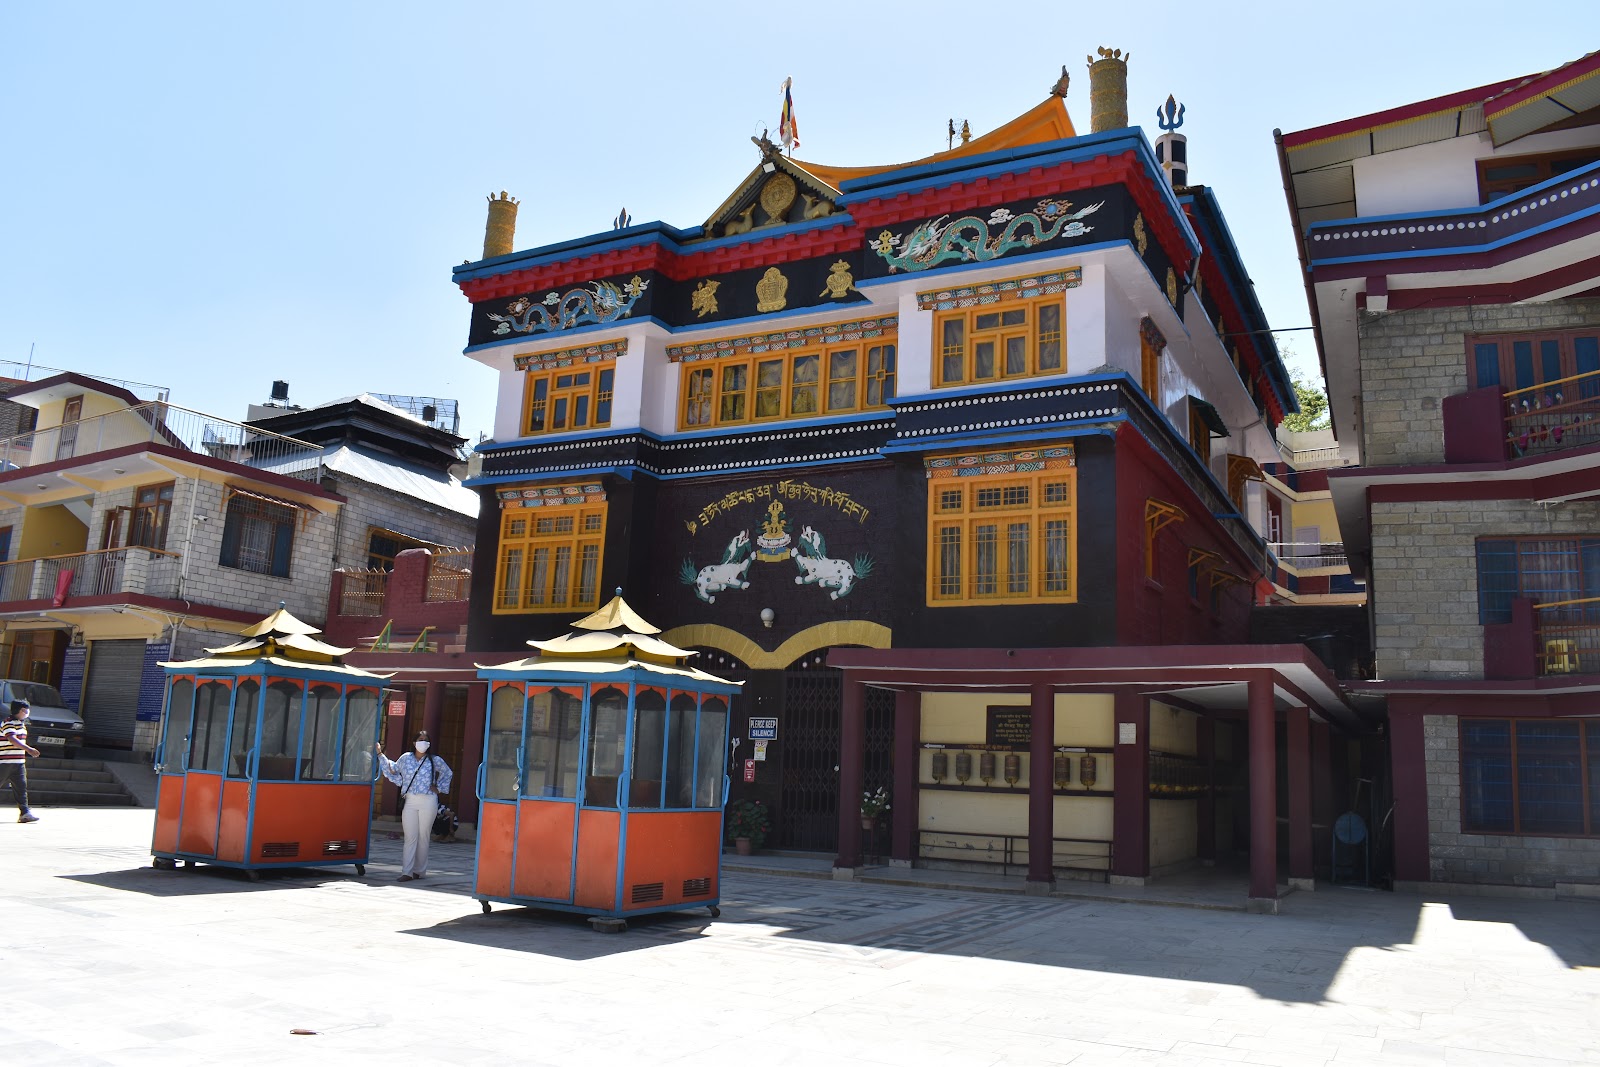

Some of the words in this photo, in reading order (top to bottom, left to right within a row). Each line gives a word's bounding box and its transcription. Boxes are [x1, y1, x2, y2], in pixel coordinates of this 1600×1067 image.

[750, 720, 765, 728] PLEASE
[765, 720, 776, 728] KEEP
[752, 729, 773, 737] SILENCE
